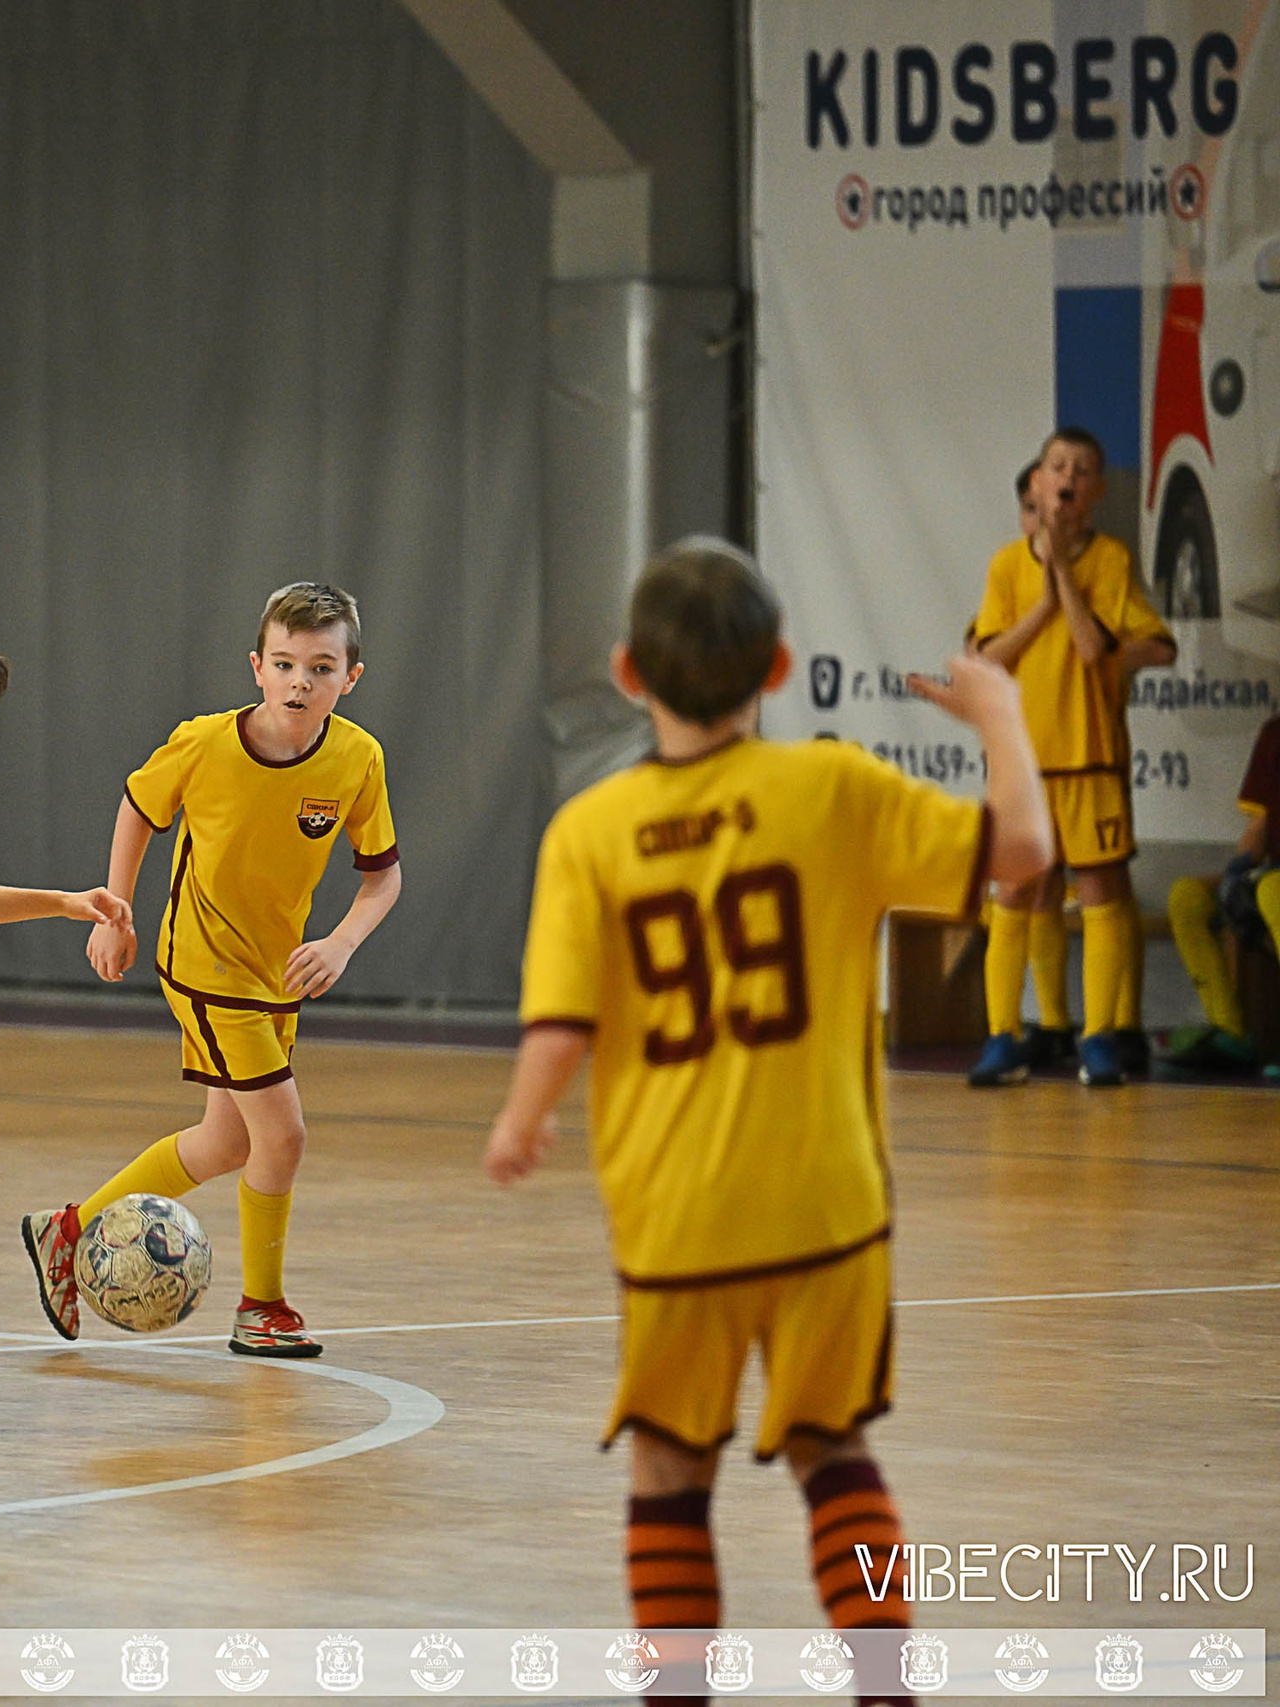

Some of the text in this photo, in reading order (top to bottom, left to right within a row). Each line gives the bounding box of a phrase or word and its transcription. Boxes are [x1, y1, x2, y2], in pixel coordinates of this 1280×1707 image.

[804, 32, 1240, 150] KIDSBERG
[871, 166, 1168, 233] город профессий
[1096, 819, 1120, 851] 17
[626, 862, 812, 1068] 99
